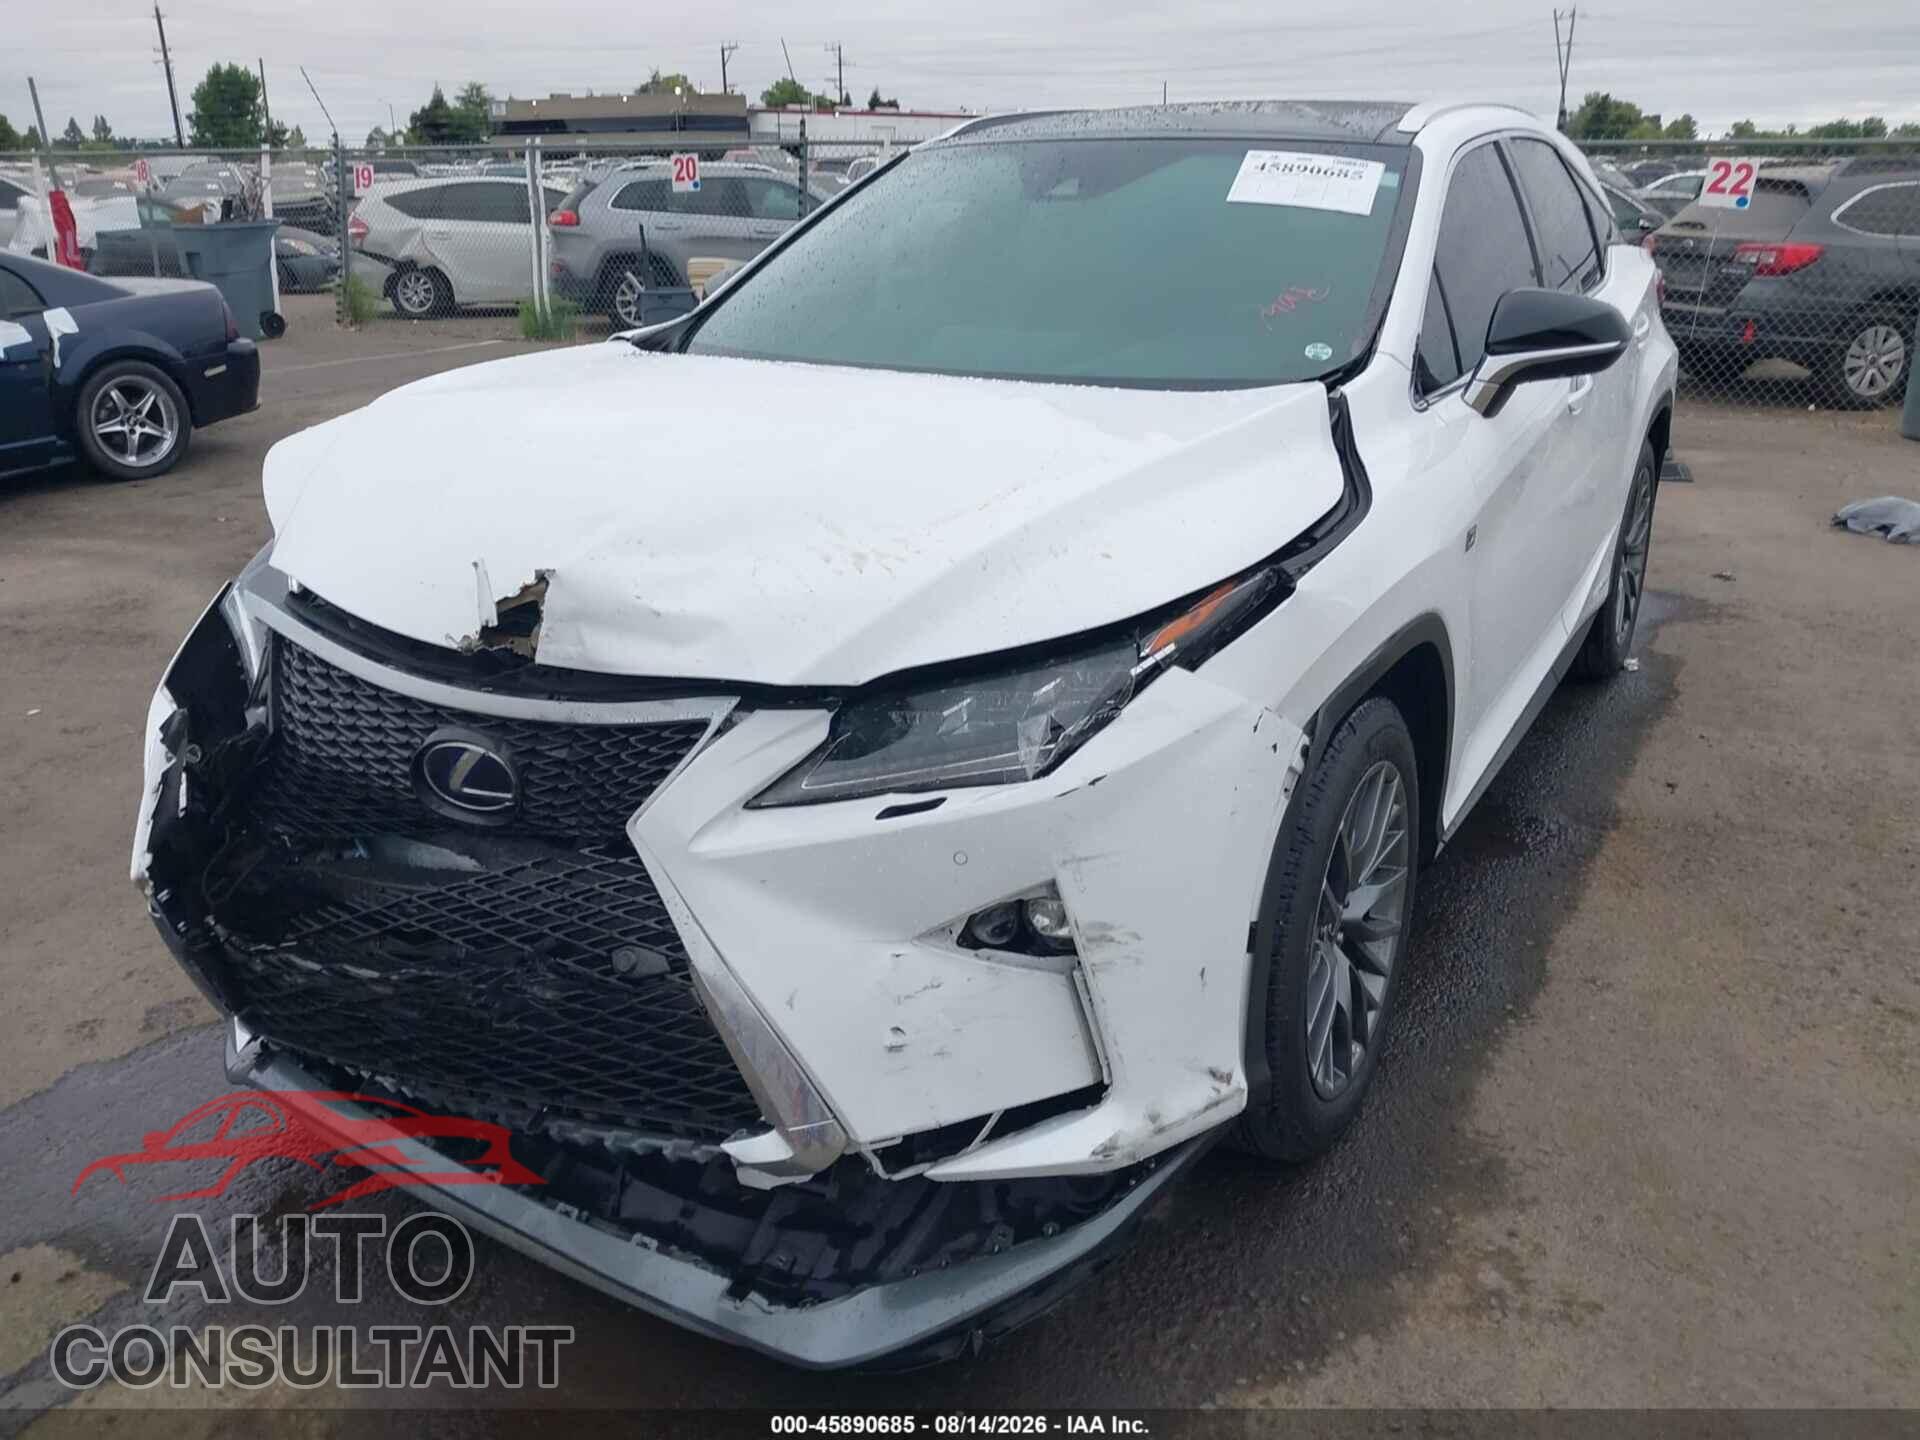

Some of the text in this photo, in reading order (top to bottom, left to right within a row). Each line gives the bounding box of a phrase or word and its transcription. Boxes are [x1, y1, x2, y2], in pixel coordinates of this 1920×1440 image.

[137, 160, 148, 182] 18
[355, 167, 372, 189] 19
[674, 156, 697, 182] 20
[1253, 161, 1365, 181] 45890685
[1706, 160, 1754, 196] 22
